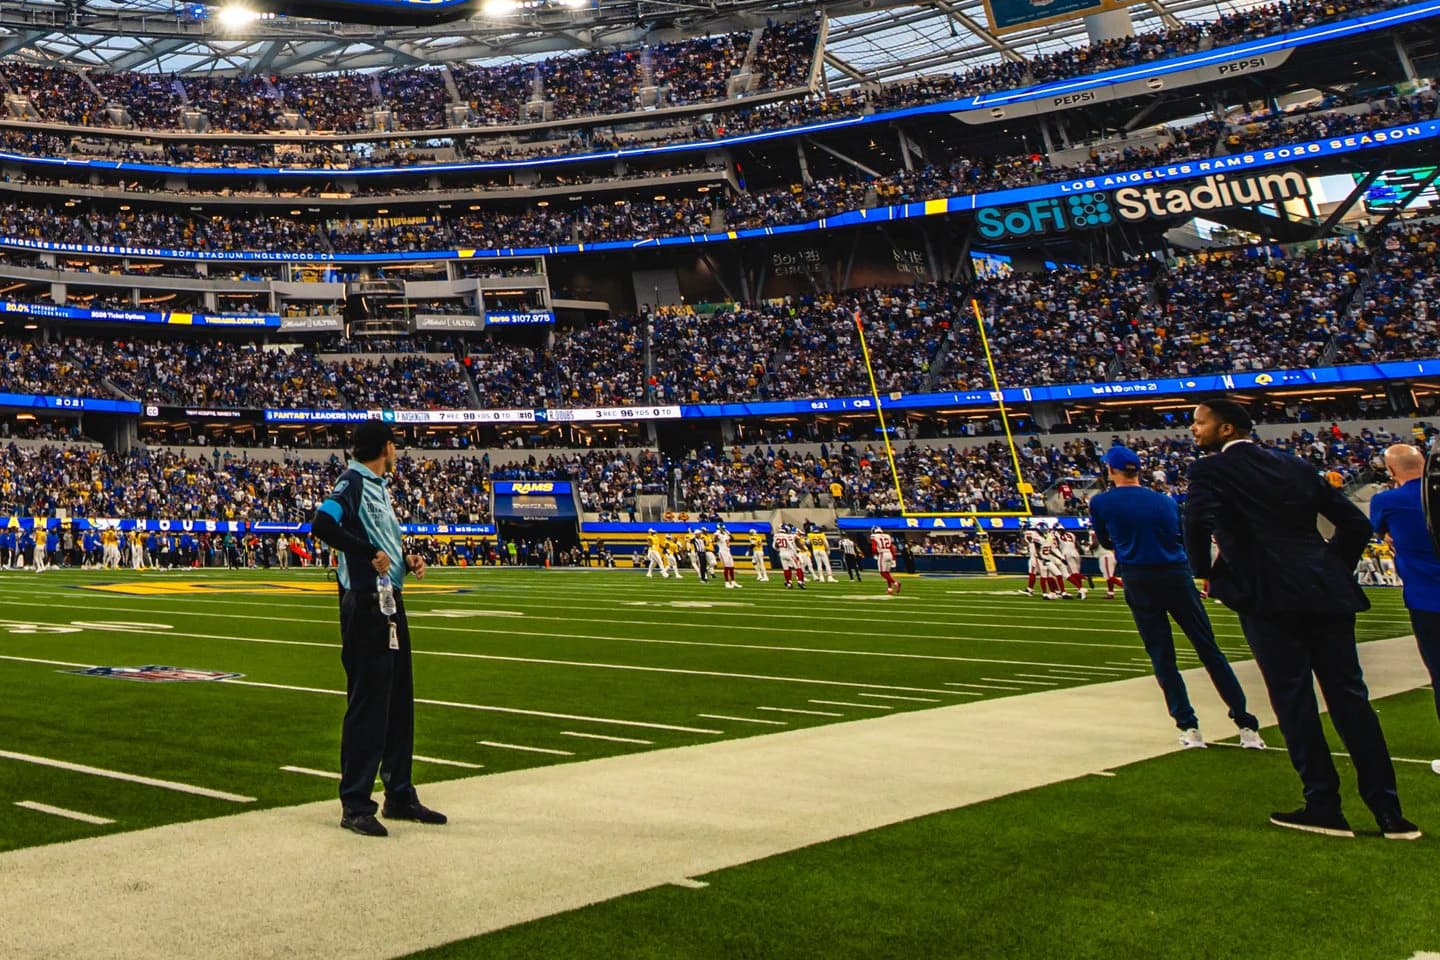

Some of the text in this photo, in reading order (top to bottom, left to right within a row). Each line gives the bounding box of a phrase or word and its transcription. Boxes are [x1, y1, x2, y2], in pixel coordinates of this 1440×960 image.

[1218, 56, 1266, 74] PEPSI
[1053, 91, 1096, 107] PEPSI
[1061, 126, 1422, 193] LOS ANGELES RAMS 2026 SEASON
[977, 170, 1309, 239] SoFi Stadium
[4, 237, 49, 249] ANGELES
[53, 243, 83, 252] RAMS
[119, 247, 161, 256] SEASON
[320, 253, 335, 261] CA
[1222, 375, 1235, 390] 14
[55, 398, 85, 408] 2021
[311, 412, 346, 420] LEADERS
[511, 482, 555, 494] RAMS
[135, 519, 239, 531] HOUSE
[906, 517, 1004, 528] RAMS
[776, 538, 788, 549] 20
